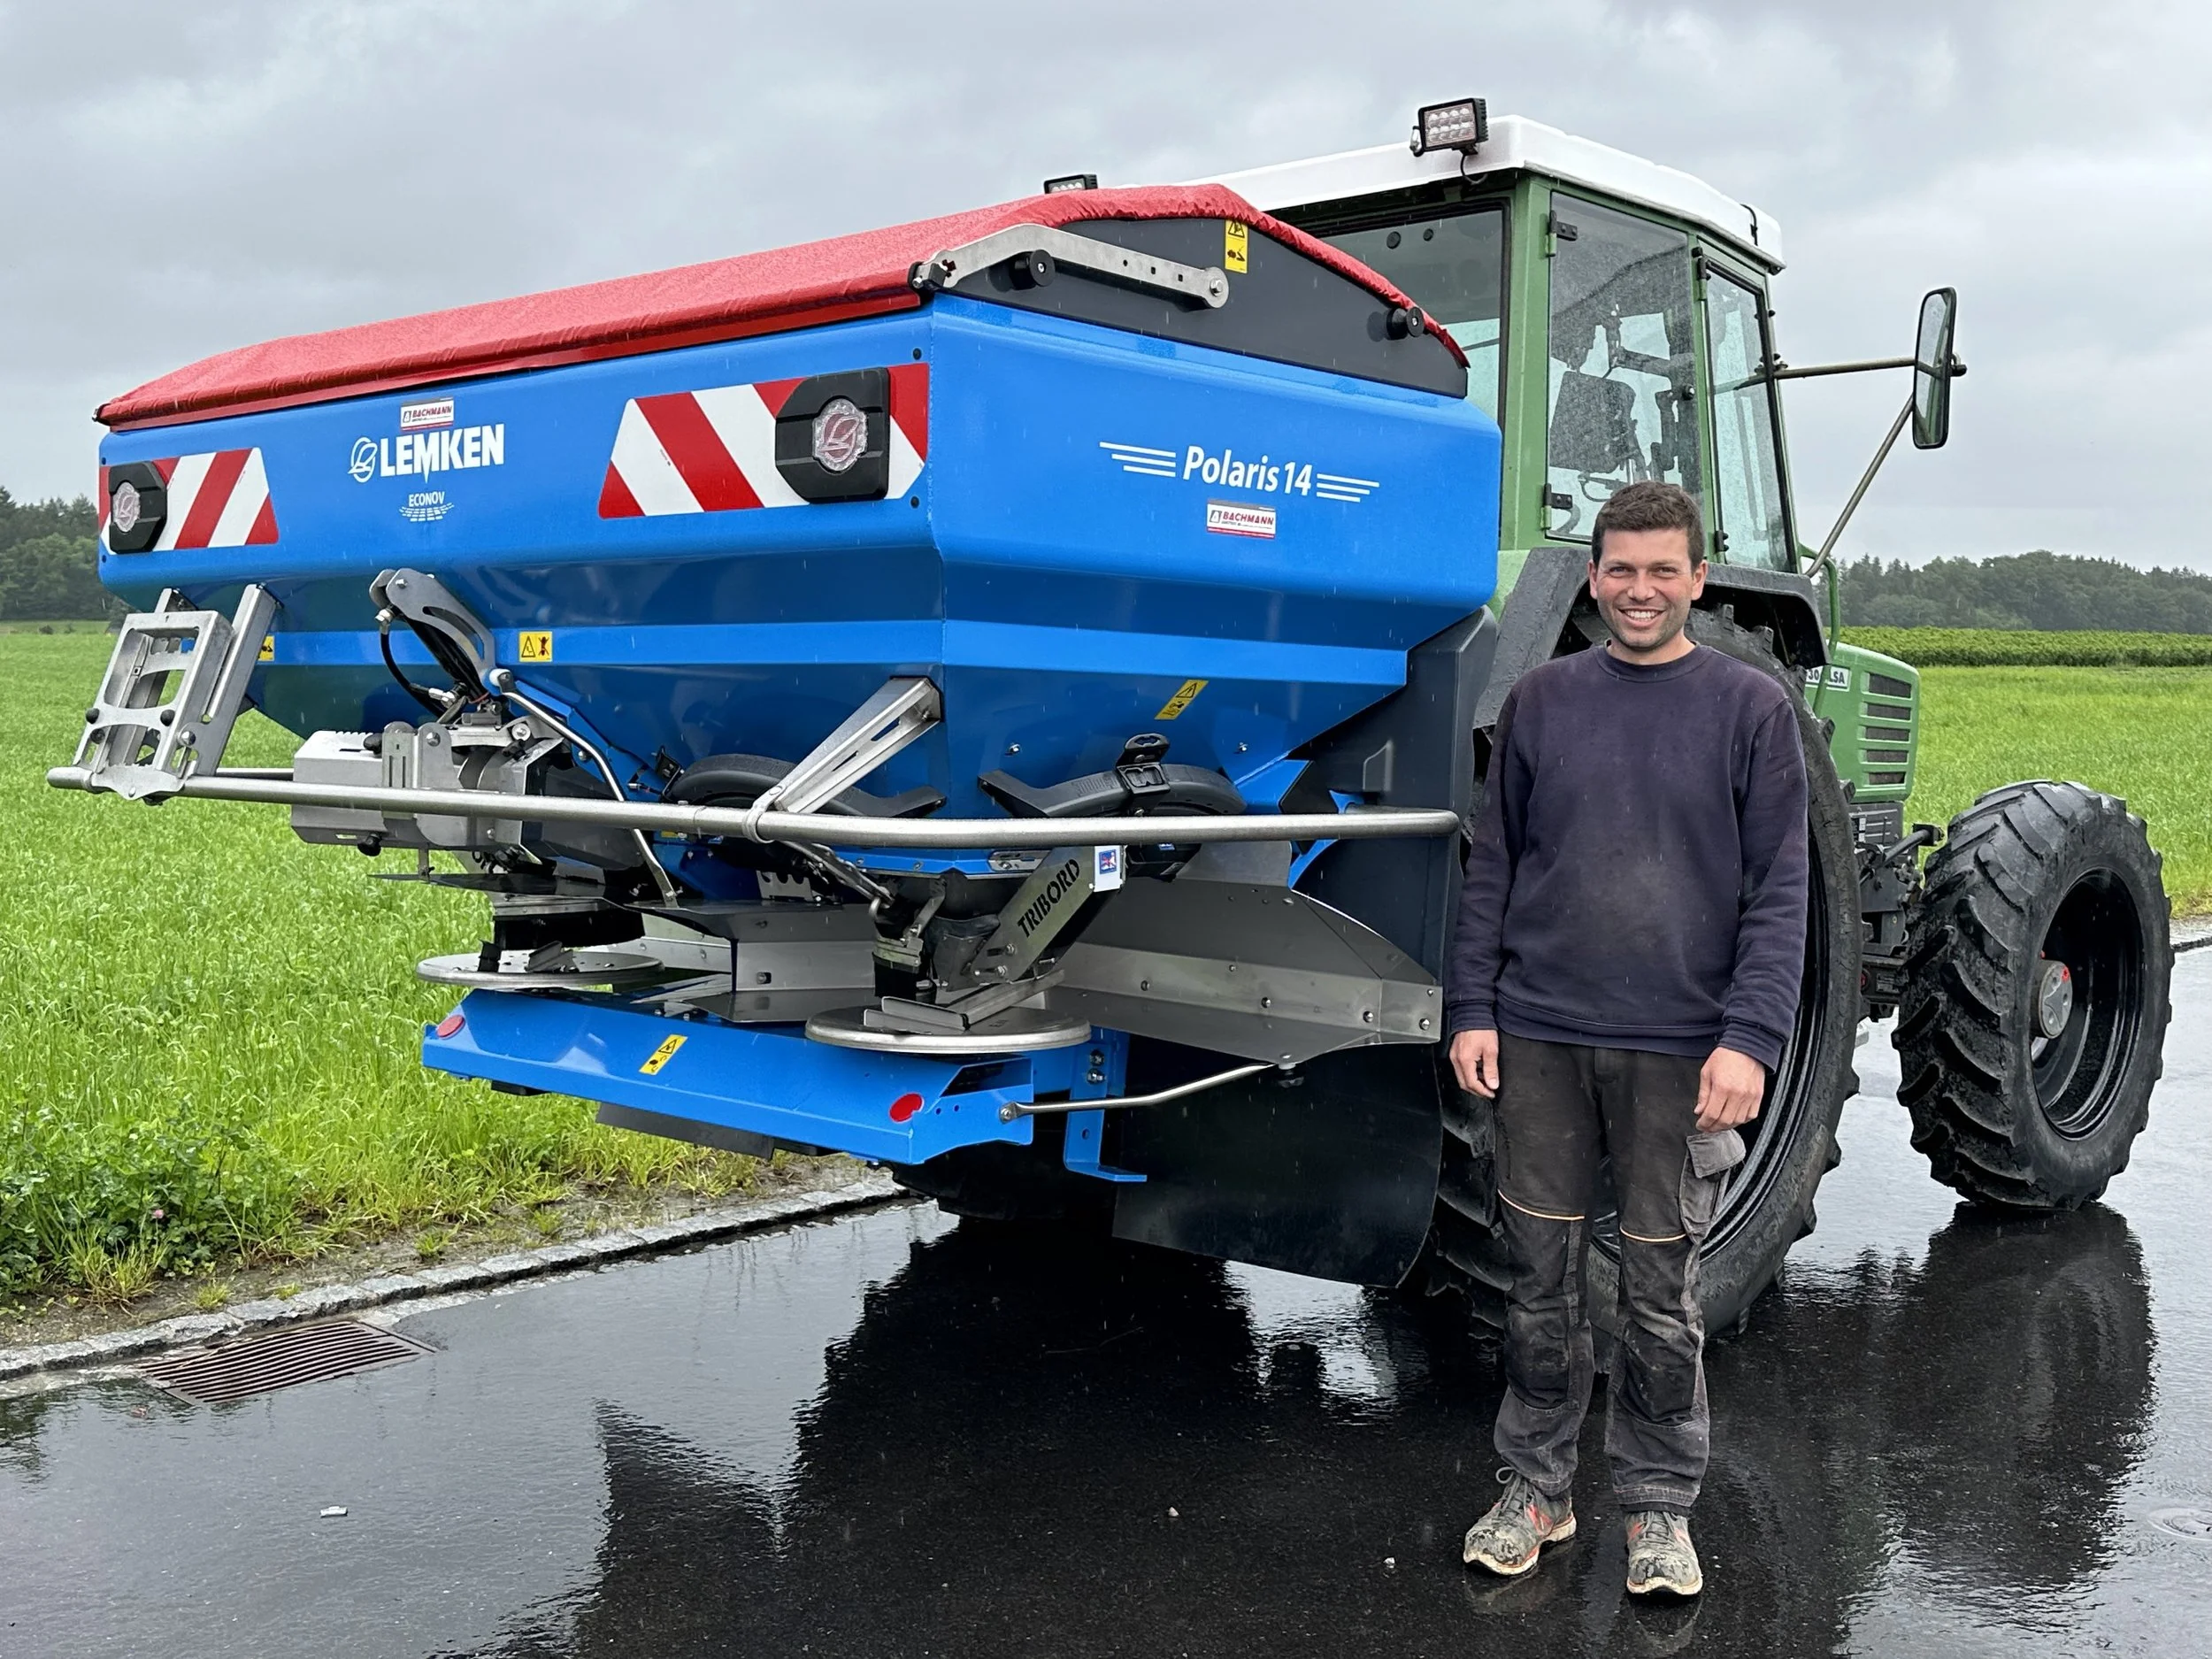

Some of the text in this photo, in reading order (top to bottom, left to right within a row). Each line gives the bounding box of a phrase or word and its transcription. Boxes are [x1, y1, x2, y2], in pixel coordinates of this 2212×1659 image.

[411, 405, 452, 419] BACHMANN
[380, 423, 504, 484] LEMKEN
[1183, 445, 1313, 496] Polaris 14
[408, 491, 445, 507] ECONOV
[1222, 511, 1274, 526] BACHMANN
[1018, 858, 1080, 938] TRIBORD
